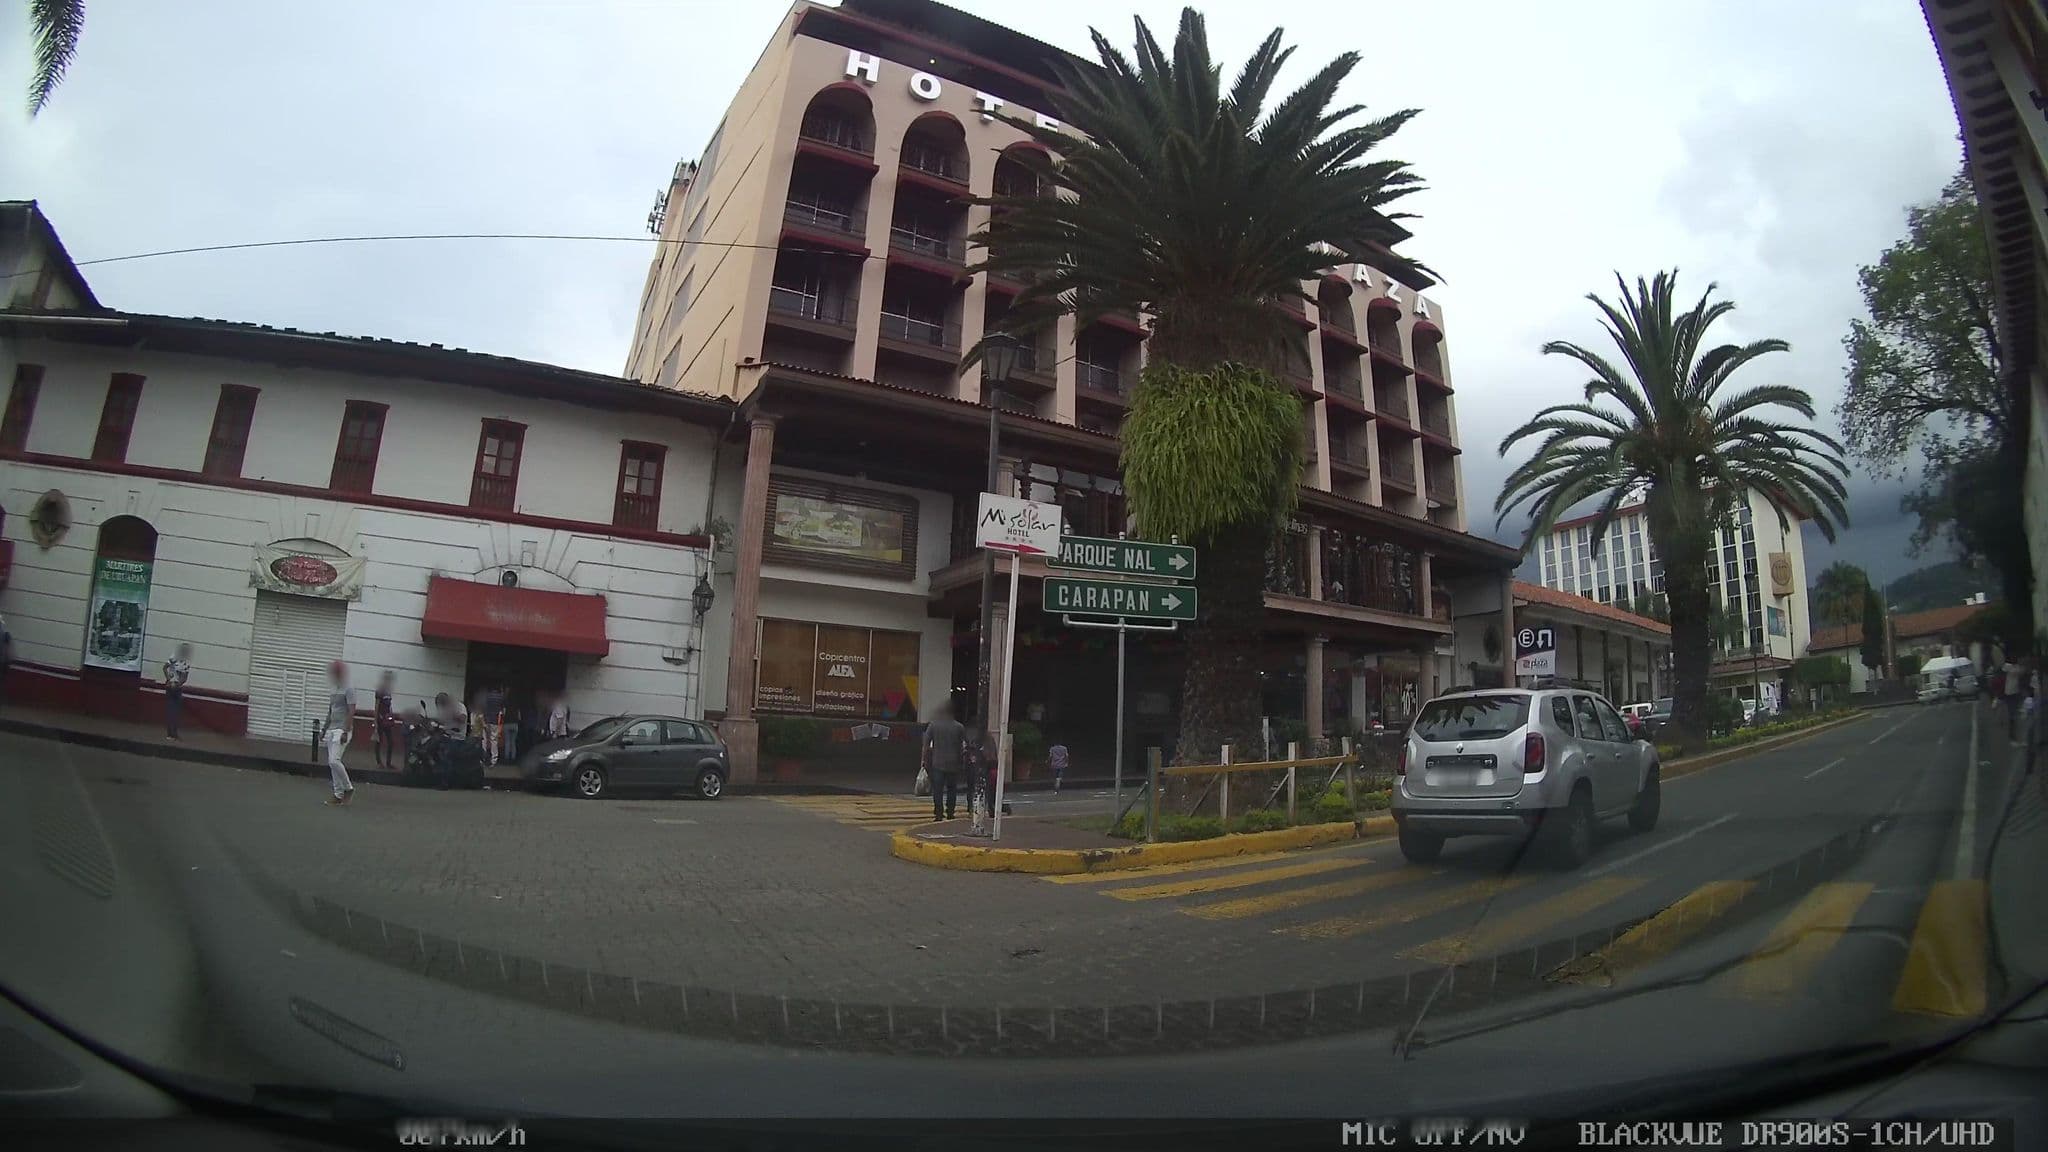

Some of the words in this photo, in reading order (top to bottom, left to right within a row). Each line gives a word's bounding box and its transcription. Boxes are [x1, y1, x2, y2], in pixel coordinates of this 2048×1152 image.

[845, 49, 1099, 149] HOTE
[981, 507, 1006, 528] Mi
[1007, 527, 1030, 538] HOTEL
[1124, 547, 1156, 571] NAL
[1058, 584, 1150, 612] CARAPAN
[818, 651, 866, 664] Copicentro
[827, 664, 856, 678] ALFA
[759, 685, 783, 695] copias
[758, 693, 801, 702] impresiones
[815, 702, 855, 711] invitaciones
